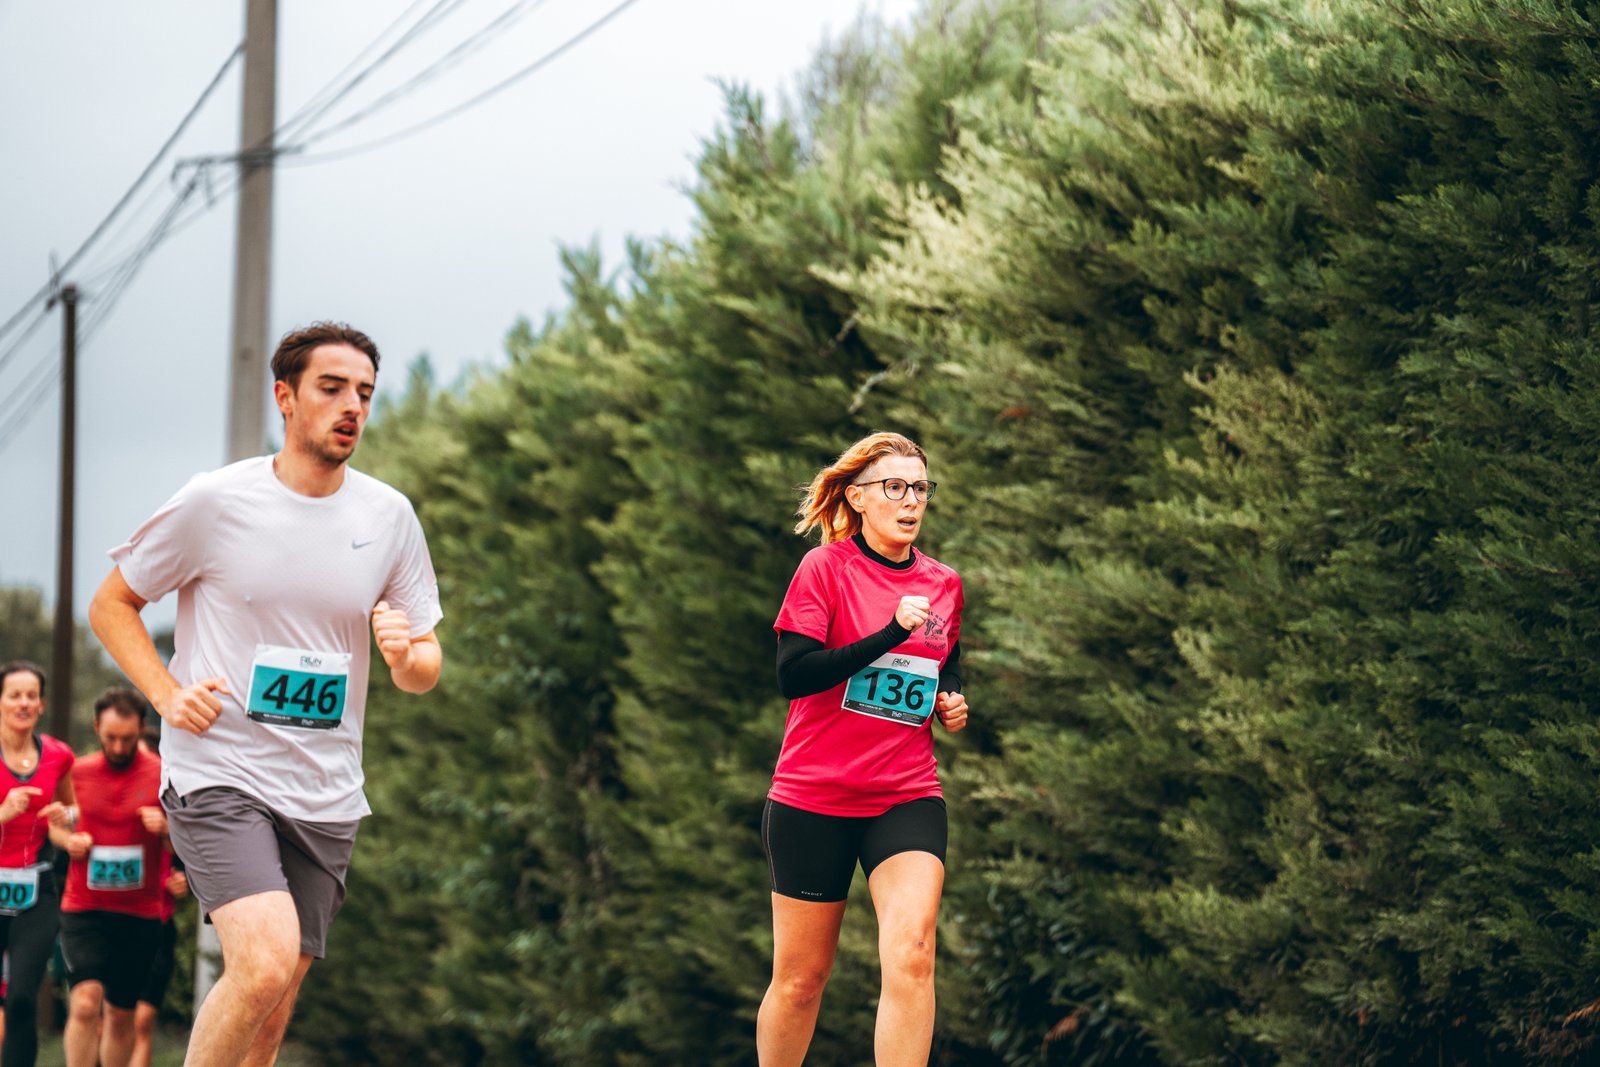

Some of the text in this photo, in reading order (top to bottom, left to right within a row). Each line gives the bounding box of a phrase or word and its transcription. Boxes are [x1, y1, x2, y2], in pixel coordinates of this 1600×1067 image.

[262, 674, 339, 715] 446
[864, 671, 926, 710] 136
[95, 862, 136, 880] 226
